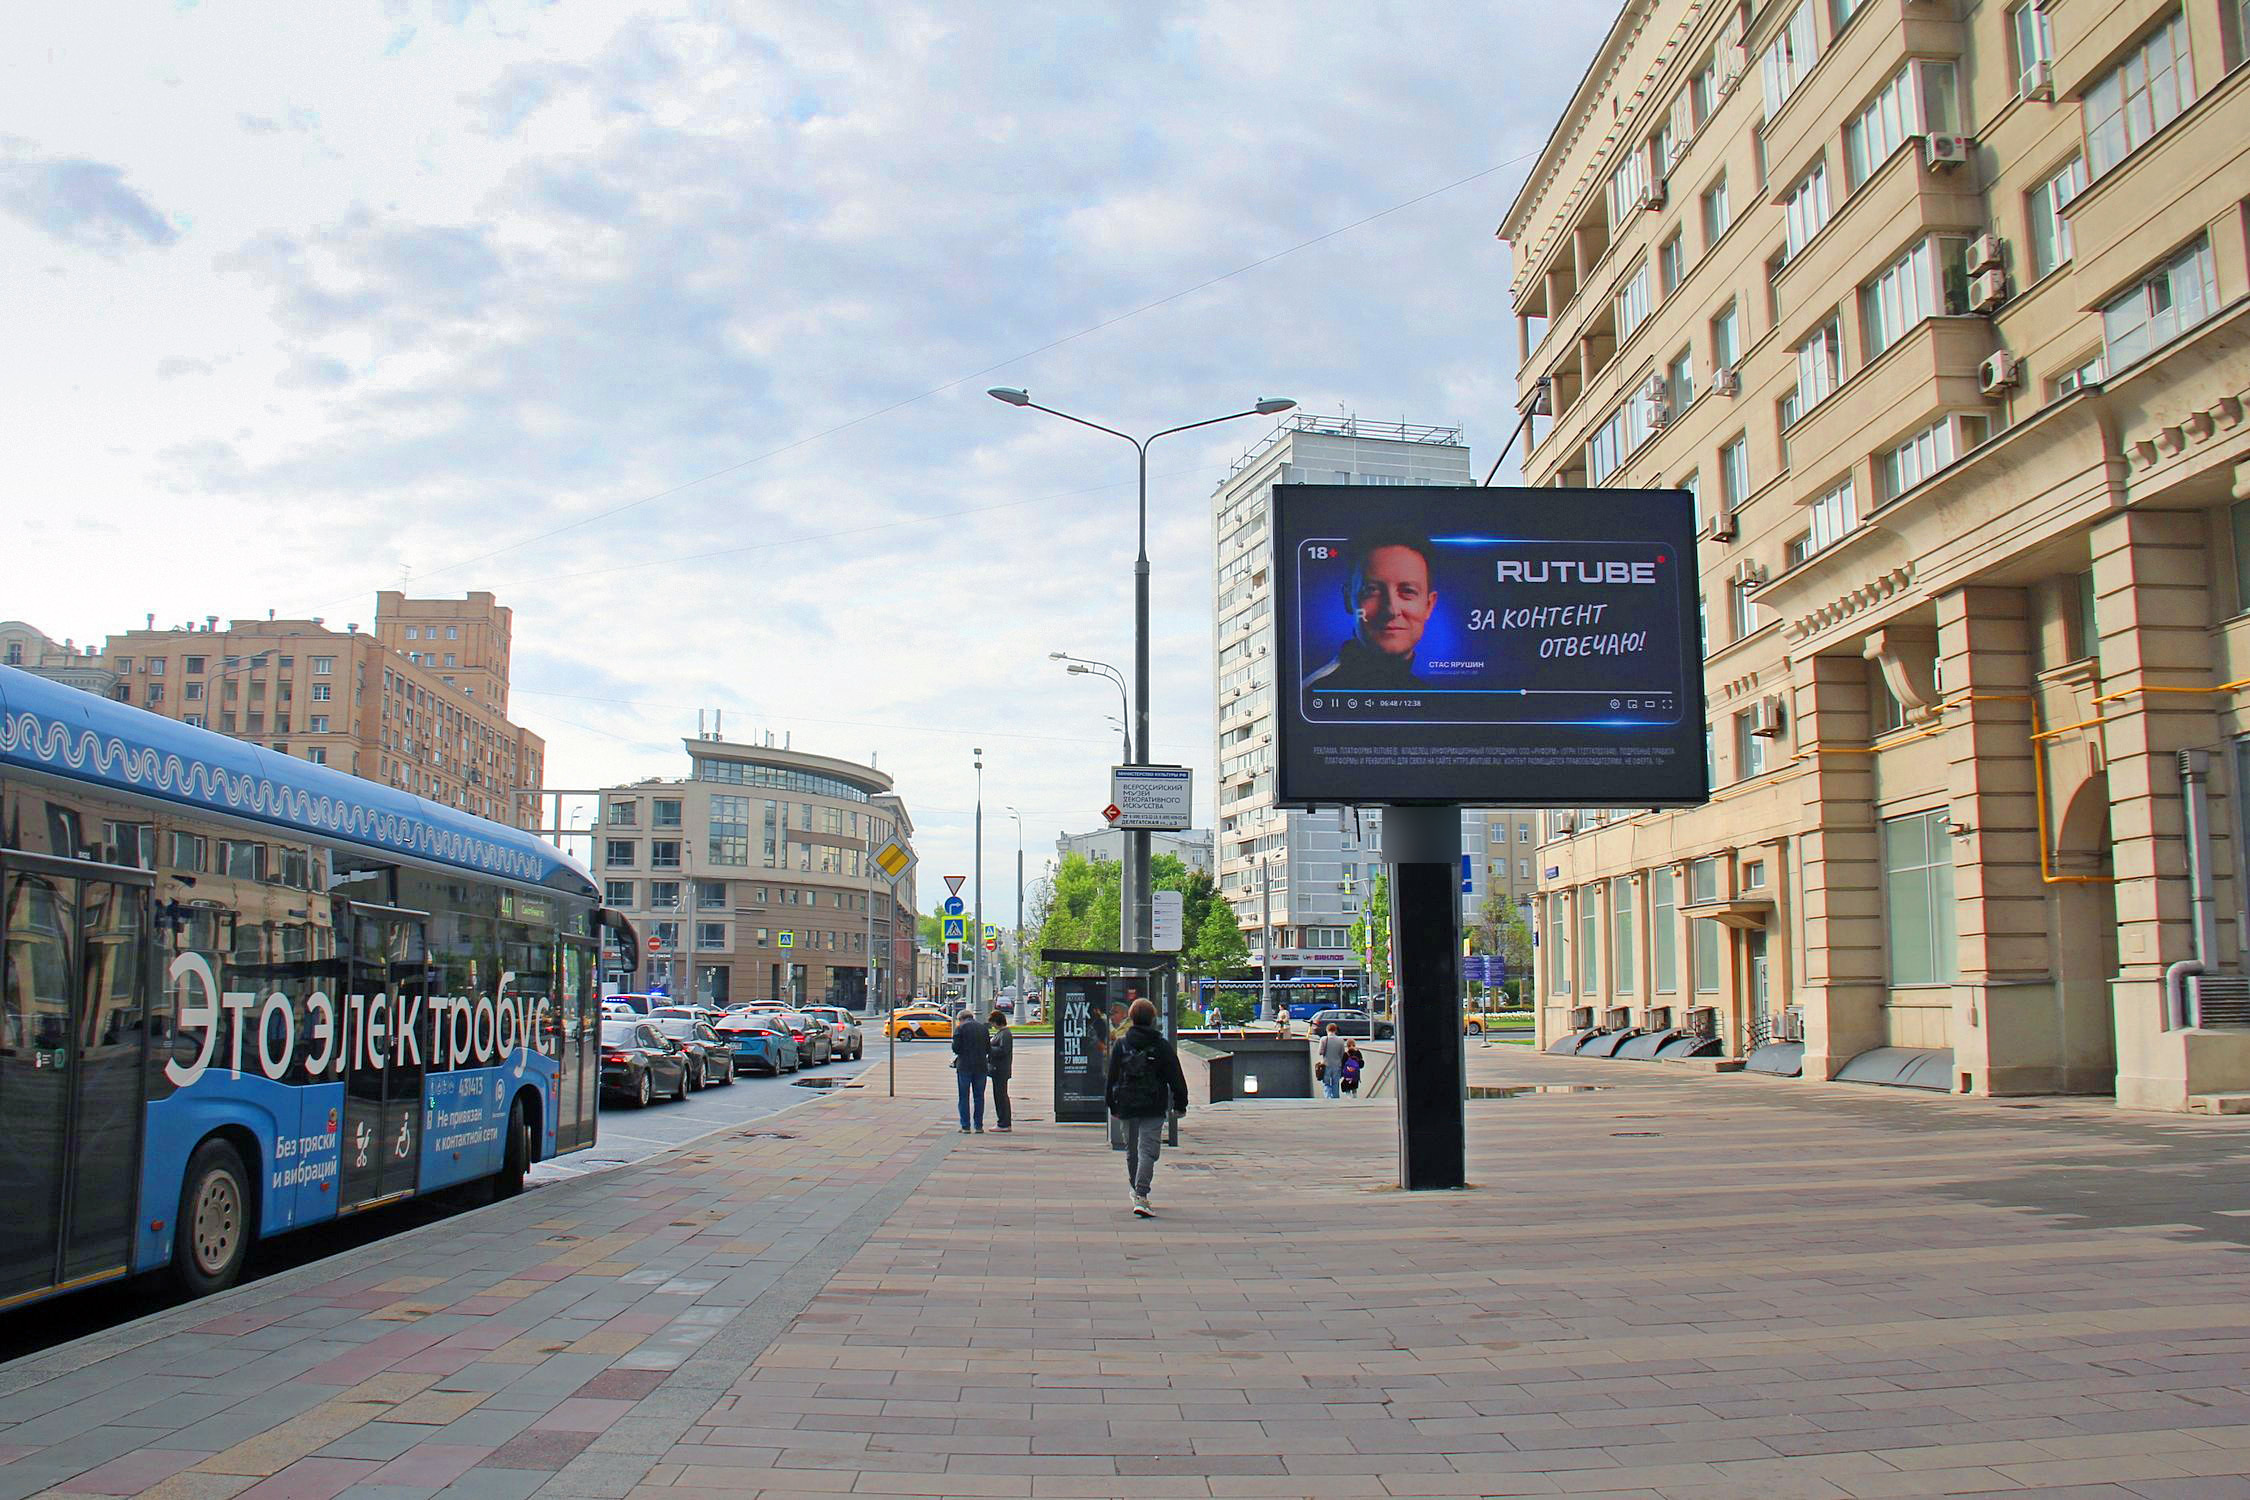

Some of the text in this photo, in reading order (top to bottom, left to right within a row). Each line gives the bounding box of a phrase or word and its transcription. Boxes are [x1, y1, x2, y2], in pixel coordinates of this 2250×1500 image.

[1307, 546, 1338, 559] 18+
[1496, 560, 1656, 584] RUTUBE
[1467, 603, 1608, 631] ЗА КОНТЕНТ
[1539, 631, 1647, 659] ОТВЕЧАЮ!
[1450, 661, 1484, 669] ЯРУШИН
[164, 951, 295, 1088] Это
[1064, 1001, 1091, 1020] АУК
[458, 1076, 484, 1096] 431413
[437, 1108, 483, 1129] Не привязан
[275, 1133, 337, 1159] Без тряски
[435, 1126, 497, 1152] к контактной сети
[272, 1155, 337, 1189] и вибраций
